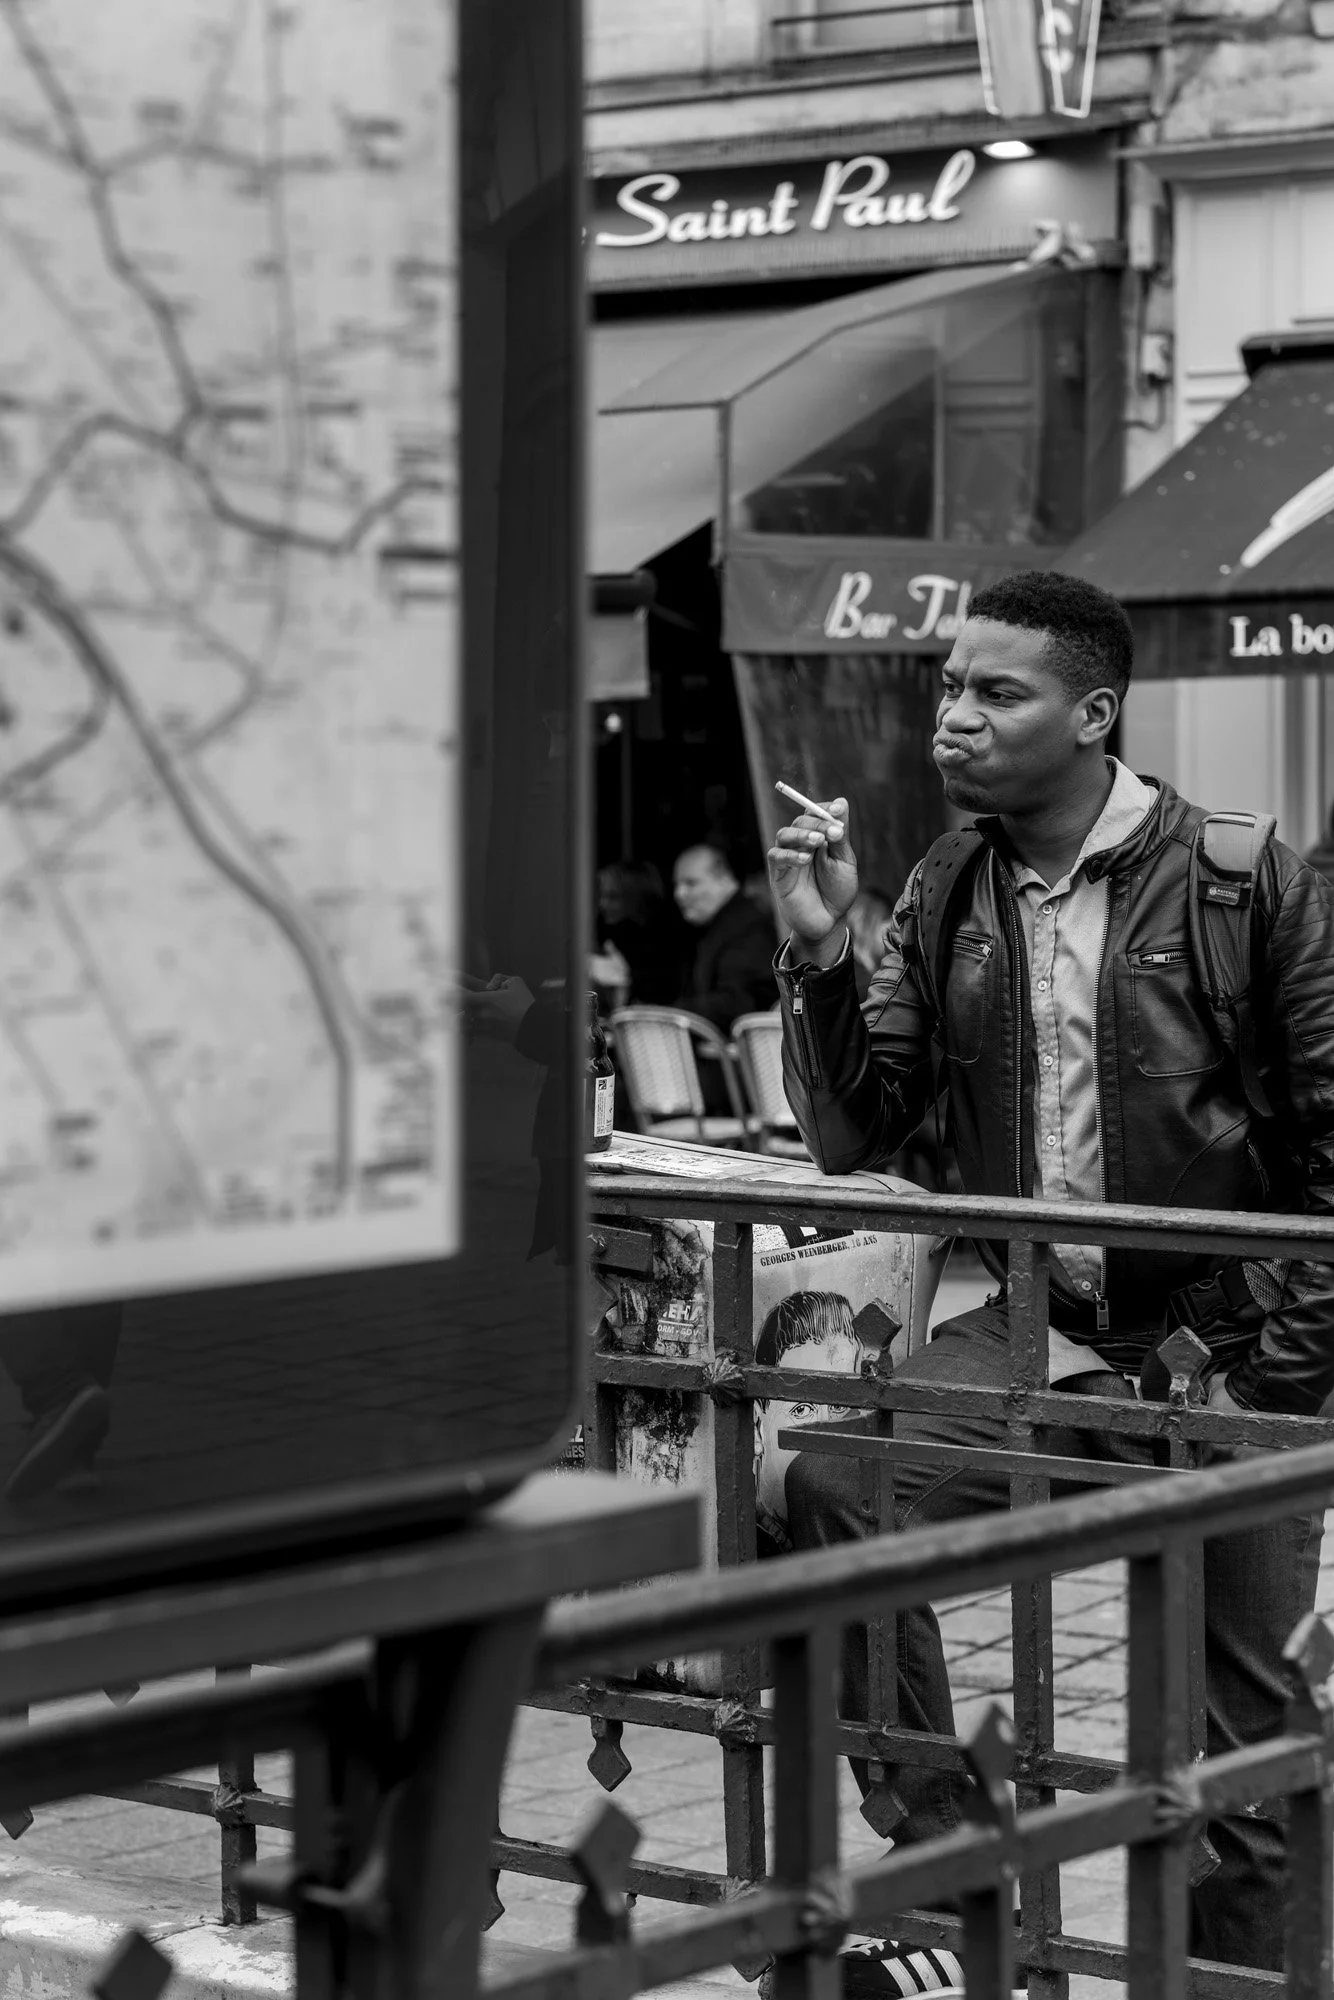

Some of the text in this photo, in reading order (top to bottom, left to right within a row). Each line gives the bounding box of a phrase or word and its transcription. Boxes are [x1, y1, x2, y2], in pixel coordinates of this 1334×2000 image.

[595, 149, 976, 247] Saint Paul
[824, 571, 898, 639] Bar
[1228, 615, 1283, 657] La
[760, 1251, 796, 1267] GEORGES
[863, 1235, 878, 1246] ANS
